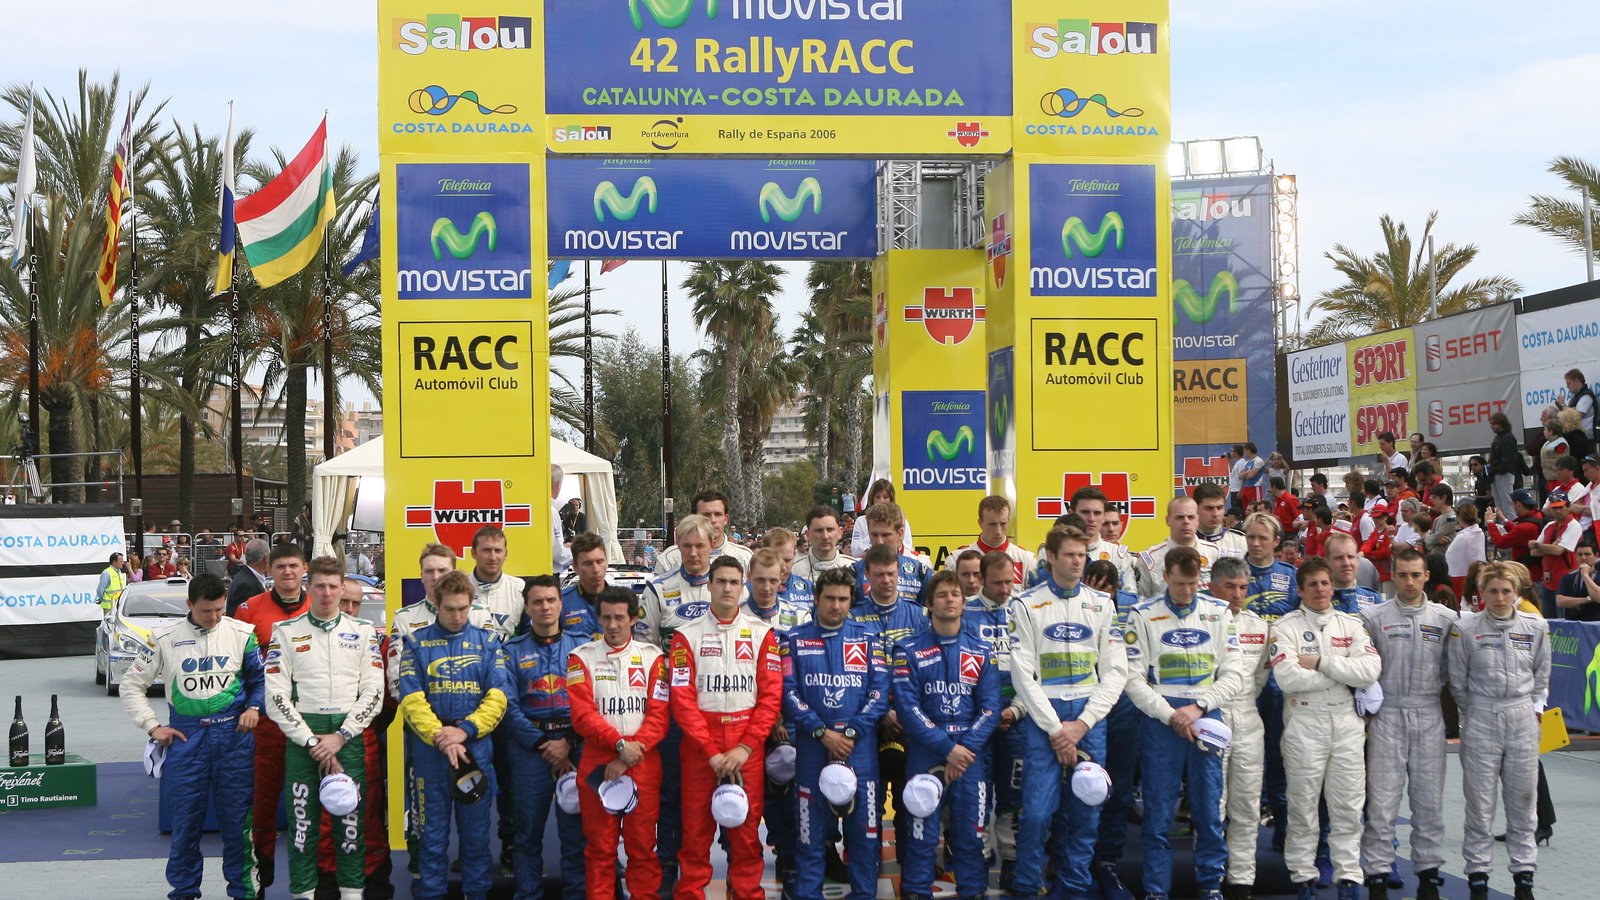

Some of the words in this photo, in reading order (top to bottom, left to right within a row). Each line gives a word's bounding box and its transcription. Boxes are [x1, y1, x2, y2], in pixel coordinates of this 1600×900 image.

[399, 21, 526, 55] Salou
[1031, 26, 1152, 58] Salou
[629, 38, 679, 73] 42
[695, 37, 914, 83] RallyRACC
[824, 88, 965, 107] DAURADA
[393, 123, 448, 134] COSTA
[452, 122, 533, 133] DAURADA
[555, 127, 609, 143] Salou
[641, 130, 689, 139] PortAventura
[718, 129, 746, 141] Rally
[749, 129, 763, 139] de
[766, 129, 807, 142] España
[810, 130, 836, 139] 2006
[1025, 124, 1076, 135] COSTA
[1081, 125, 1159, 136] DAURADA
[565, 230, 683, 250] movistar
[731, 231, 848, 250] movistar
[324, 272, 331, 289] LA
[397, 270, 532, 292] movistar
[1030, 267, 1157, 289] movistar
[1173, 335, 1239, 349] movistar
[1446, 329, 1502, 359] SEAT
[1522, 331, 1555, 349] COSTA
[1557, 322, 1600, 344] DAURAD
[413, 336, 519, 370] RACC
[664, 345, 669, 362] DE
[1045, 332, 1144, 366] RACC
[1291, 354, 1342, 384] Gestetner
[1354, 341, 1407, 388] SPORT
[414, 377, 484, 390] Automóvil
[488, 377, 518, 389] Club
[585, 375, 592, 391] DE
[1045, 373, 1111, 386] Automóvil
[1115, 373, 1143, 385] Club
[1174, 367, 1239, 391] RACC
[1219, 394, 1239, 402] Club
[1526, 388, 1557, 406] COSTA
[1449, 400, 1508, 426] SEAT
[1294, 410, 1346, 438] Gestetner
[1356, 401, 1409, 446] SPORT
[903, 468, 986, 485] movista
[0, 535, 43, 548] OSTA
[47, 534, 121, 548] DAURADA
[1053, 624, 1083, 638] Ford
[1171, 630, 1200, 644] Ford
[184, 674, 231, 691] OMV
[805, 673, 862, 688] GAULOISES
[553, 696, 570, 708] Bu
[272, 694, 302, 728] Stobart
[20, 795, 38, 803] Timo
[40, 794, 78, 802] Rautiainen
